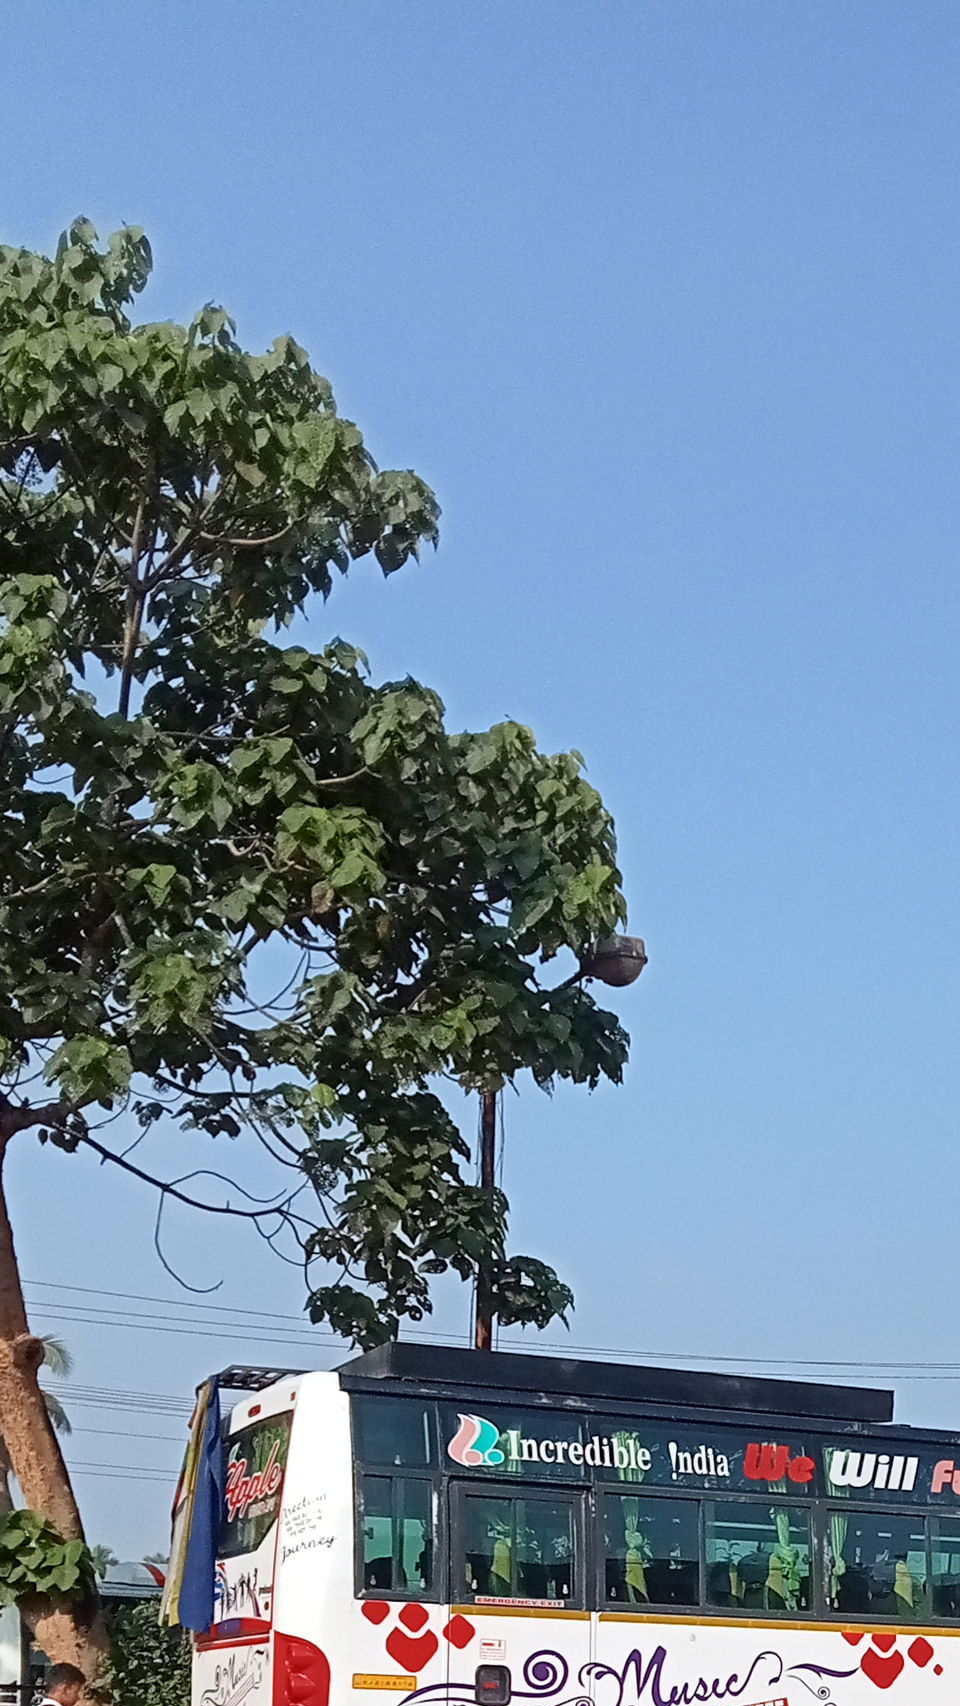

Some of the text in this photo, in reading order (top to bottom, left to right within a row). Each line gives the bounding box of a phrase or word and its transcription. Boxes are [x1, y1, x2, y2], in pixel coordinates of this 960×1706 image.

[507, 1429, 652, 1471] Incredible
[744, 1442, 816, 1483] We
[829, 1450, 919, 1491] Will
[476, 1597, 538, 1606] EMERGENCY
